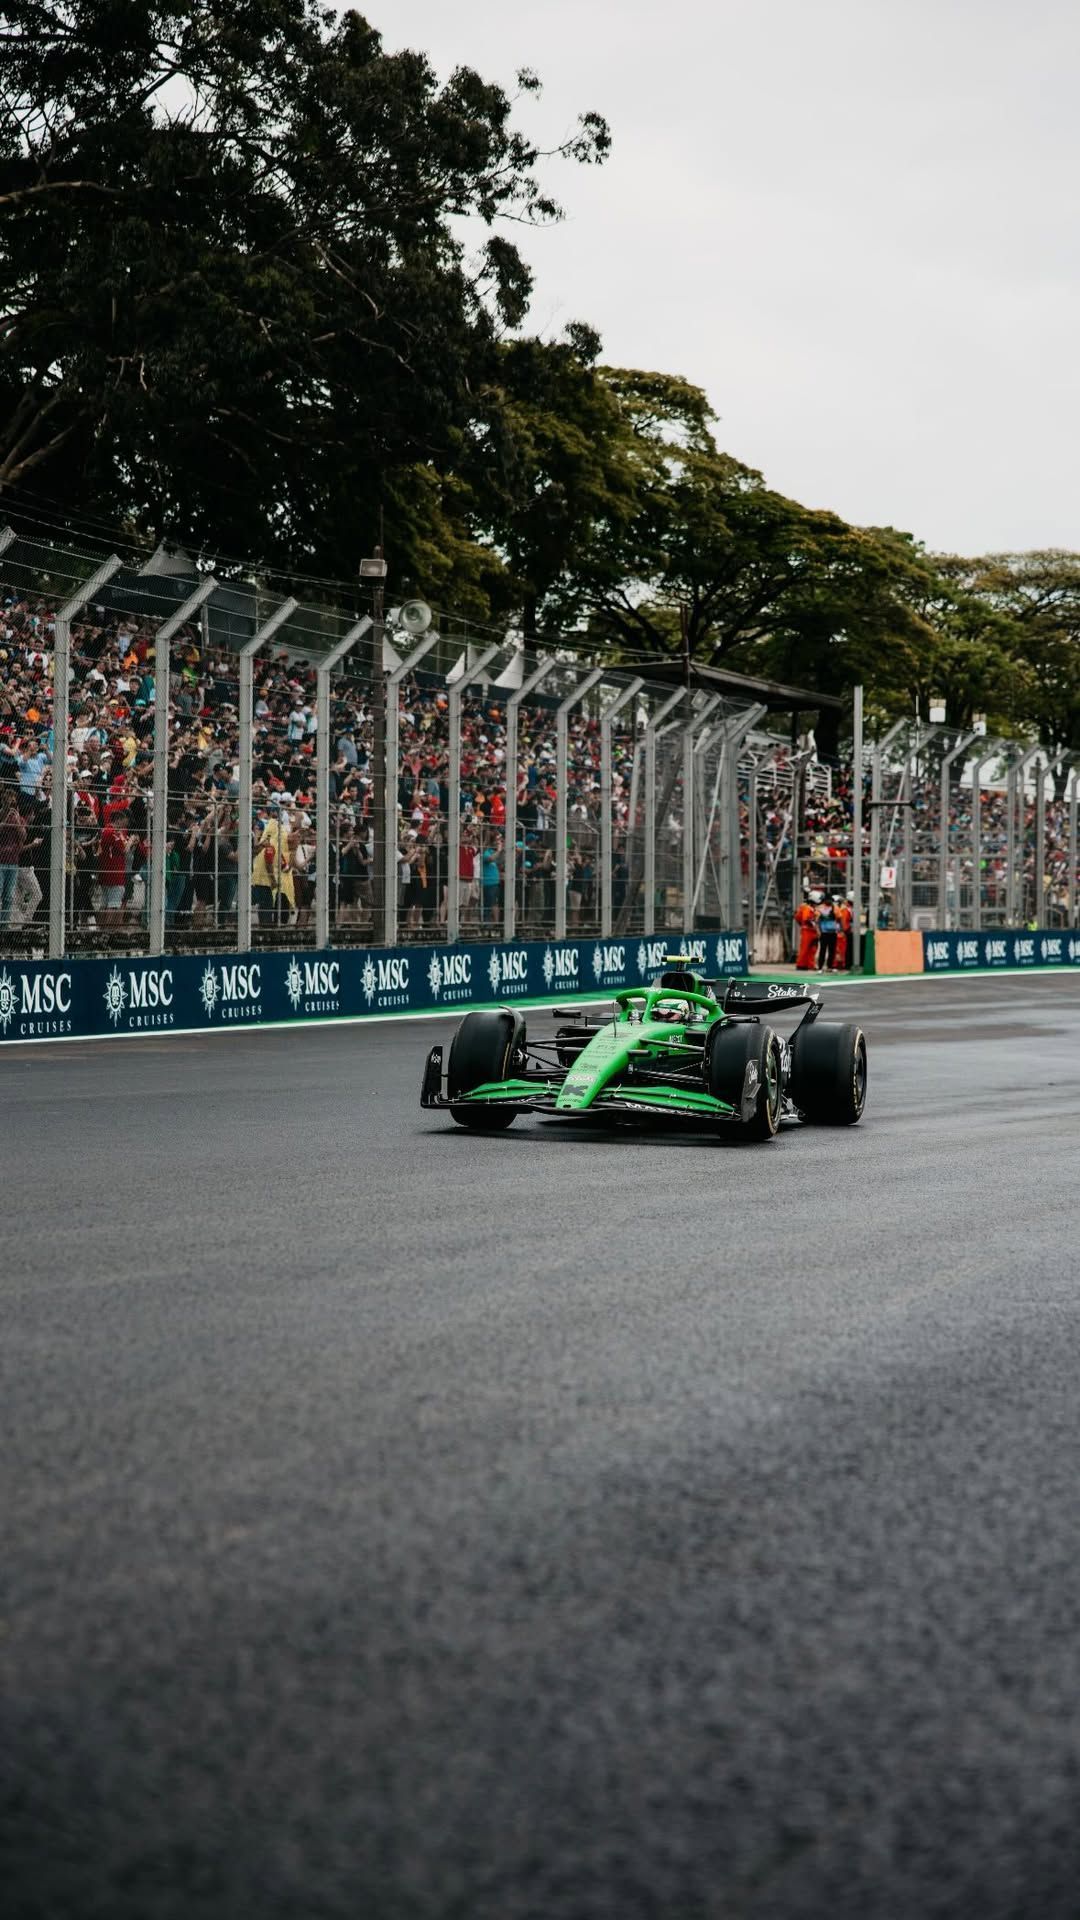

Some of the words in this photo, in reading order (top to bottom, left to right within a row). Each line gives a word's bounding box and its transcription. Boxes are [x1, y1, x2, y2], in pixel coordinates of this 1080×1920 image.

[443, 954, 472, 985] MSC
[501, 951, 528, 980] MSC
[555, 948, 579, 977] MSC
[603, 945, 626, 972] MSC
[221, 964, 261, 1000] MSC
[304, 961, 340, 995] MSC
[378, 958, 410, 991] MSC
[21, 973, 72, 1014] MSC
[129, 969, 173, 1009] MSC
[378, 994, 410, 1007] CRUISES
[443, 988, 473, 1001] CRUISES
[502, 983, 528, 995] CRUISES
[767, 984, 798, 998] Stake
[222, 1005, 262, 1019] CRUISES
[305, 1000, 341, 1012] CRUISES
[20, 1020, 72, 1035] CRUISES
[129, 1013, 174, 1028] CRUISES
